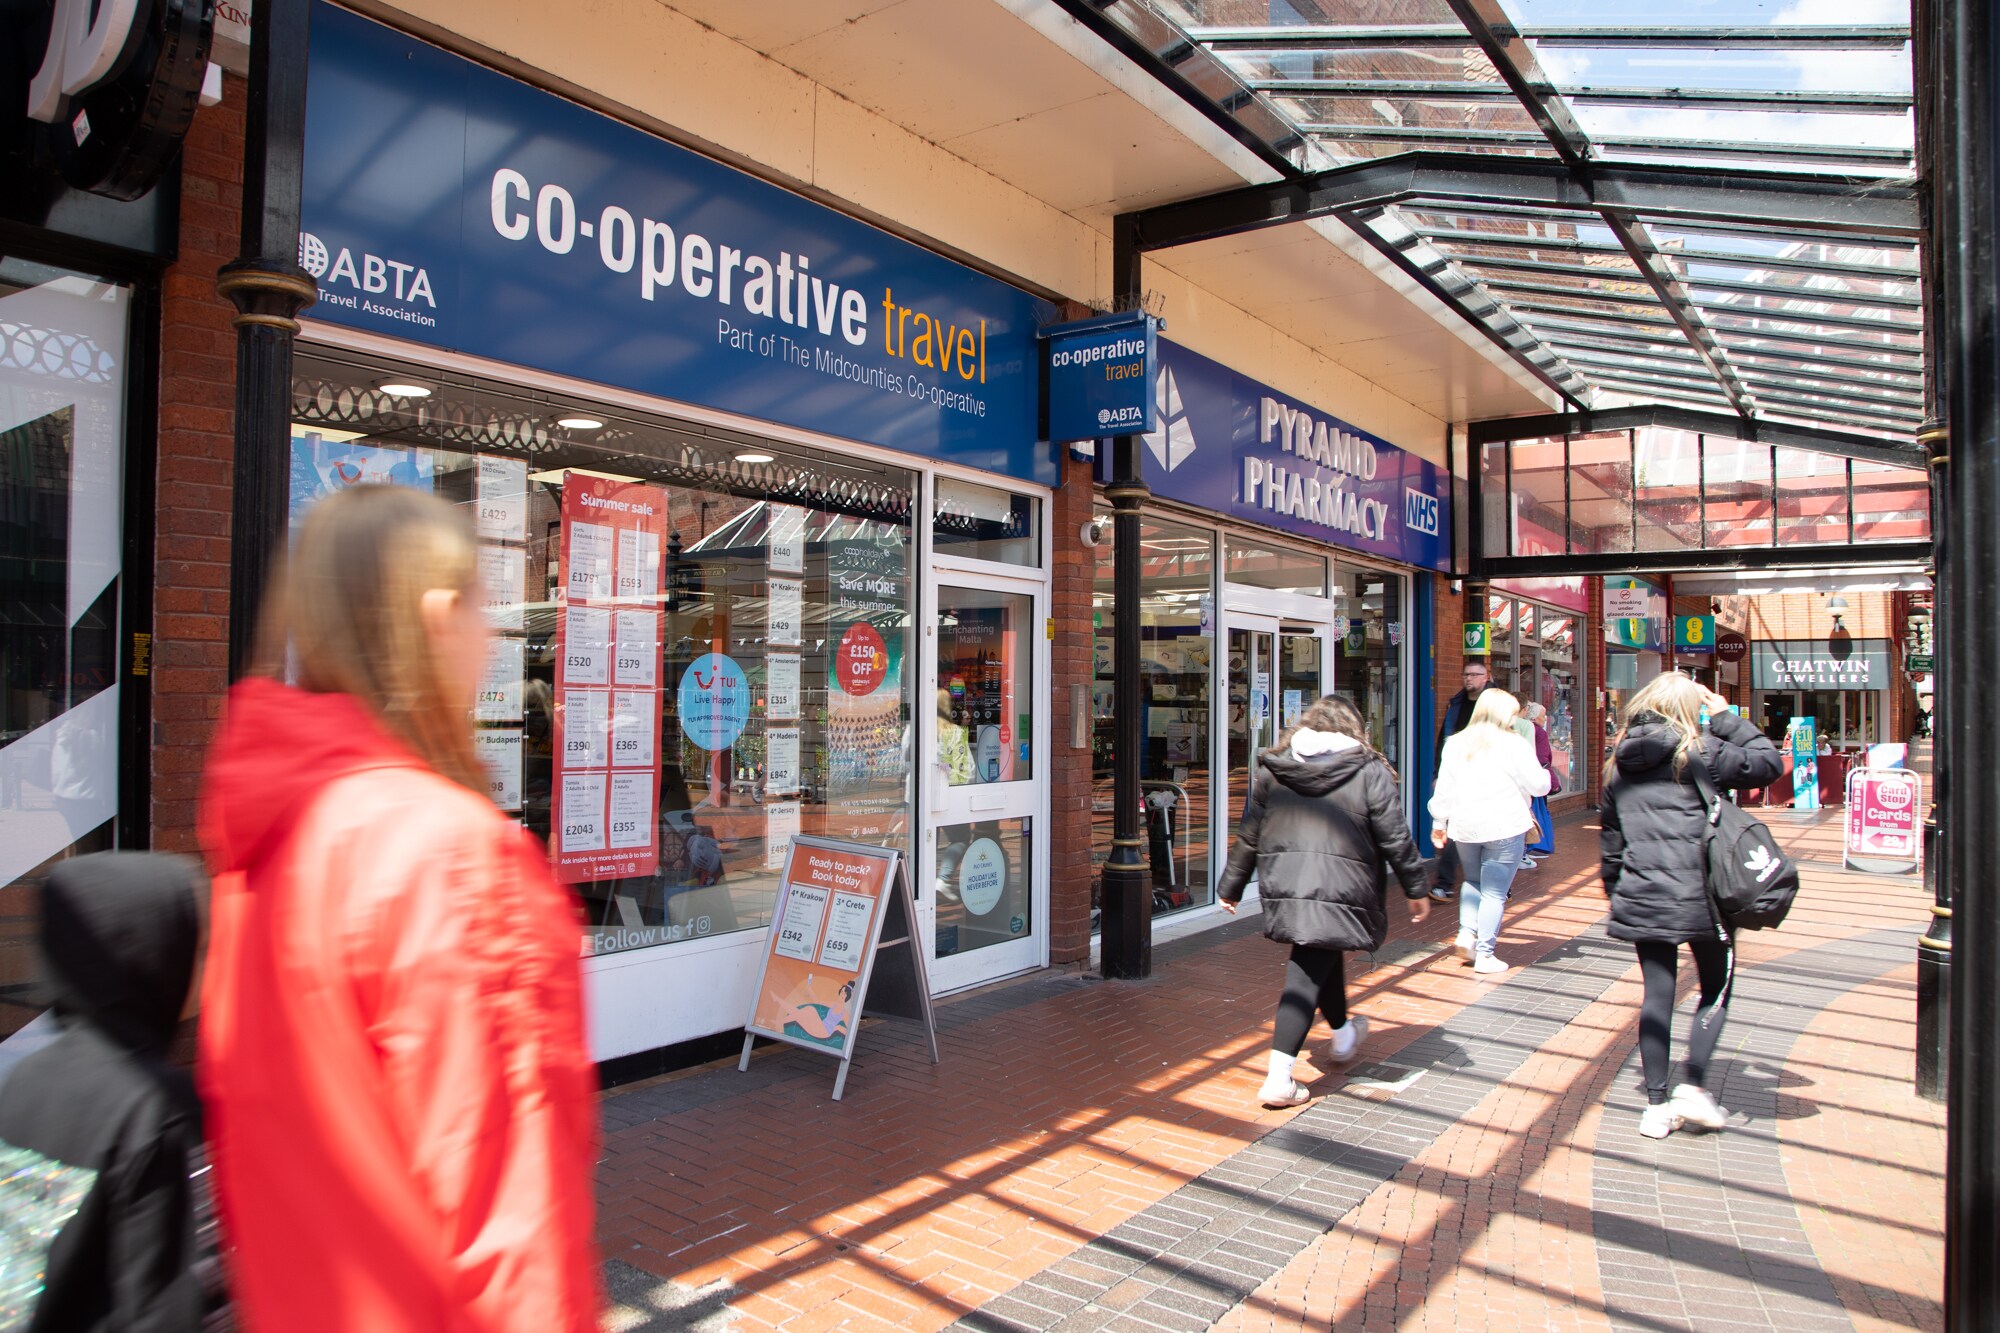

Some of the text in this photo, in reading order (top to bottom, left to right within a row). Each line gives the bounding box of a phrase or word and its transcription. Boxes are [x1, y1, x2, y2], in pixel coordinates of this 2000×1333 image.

[491, 168, 867, 346] co-operative
[328, 247, 437, 308] ABTA
[317, 288, 436, 328] Travel Association
[882, 287, 986, 384] travel
[1052, 339, 1145, 367] co-operative
[718, 319, 986, 417] Part of The Midcounties Co-operative
[1105, 358, 1143, 381] travel
[1110, 406, 1142, 422] ABTA
[1119, 420, 1143, 428] Association
[1260, 397, 1377, 481] PYRAMID
[580, 492, 653, 516] Summer sale
[1244, 456, 1388, 541] PHARMACY
[481, 508, 507, 520] £429
[1408, 490, 1437, 532] NHS
[773, 546, 791, 557] £440
[778, 583, 800, 592] Krakow
[839, 576, 896, 594] Save MORE
[840, 593, 896, 612] this summer
[771, 621, 790, 630] £429
[948, 625, 995, 635] Enchanting
[857, 634, 864, 642] Up
[960, 635, 981, 644] Malta
[850, 644, 875, 658] £150
[567, 656, 592, 667] £520
[618, 658, 640, 669] £379
[1772, 660, 1870, 673] CHATWIN
[852, 662, 872, 675] OFF
[719, 677, 736, 688] TUI
[1776, 674, 1869, 683] JEWELLERS
[694, 694, 736, 706] Live Happy
[770, 695, 787, 704] £315
[697, 714, 724, 722] APPROVED
[724, 715, 740, 724] AGENT
[486, 735, 521, 745] Budapest
[776, 732, 798, 740] Madeira
[1796, 729, 1812, 741] £10
[567, 741, 590, 751] £390
[615, 740, 638, 750] £365
[1796, 741, 1813, 752] SIMS
[770, 770, 788, 779] £842
[1880, 785, 1907, 795] Card
[1880, 794, 1906, 804] Stop
[1867, 807, 1912, 822] Cards
[565, 824, 594, 836] £2043
[612, 821, 636, 832] £355
[1879, 821, 1898, 829] from
[809, 856, 871, 875] Ready to pack?
[812, 870, 861, 888] Book today
[968, 871, 997, 883] HOLIDAY LIKE
[967, 879, 998, 892] NEVER BEFORE
[799, 890, 825, 902] Krakow
[846, 900, 866, 910] Crete
[594, 924, 681, 953] Follow us
[782, 930, 803, 942] £342
[826, 940, 848, 952] £659
